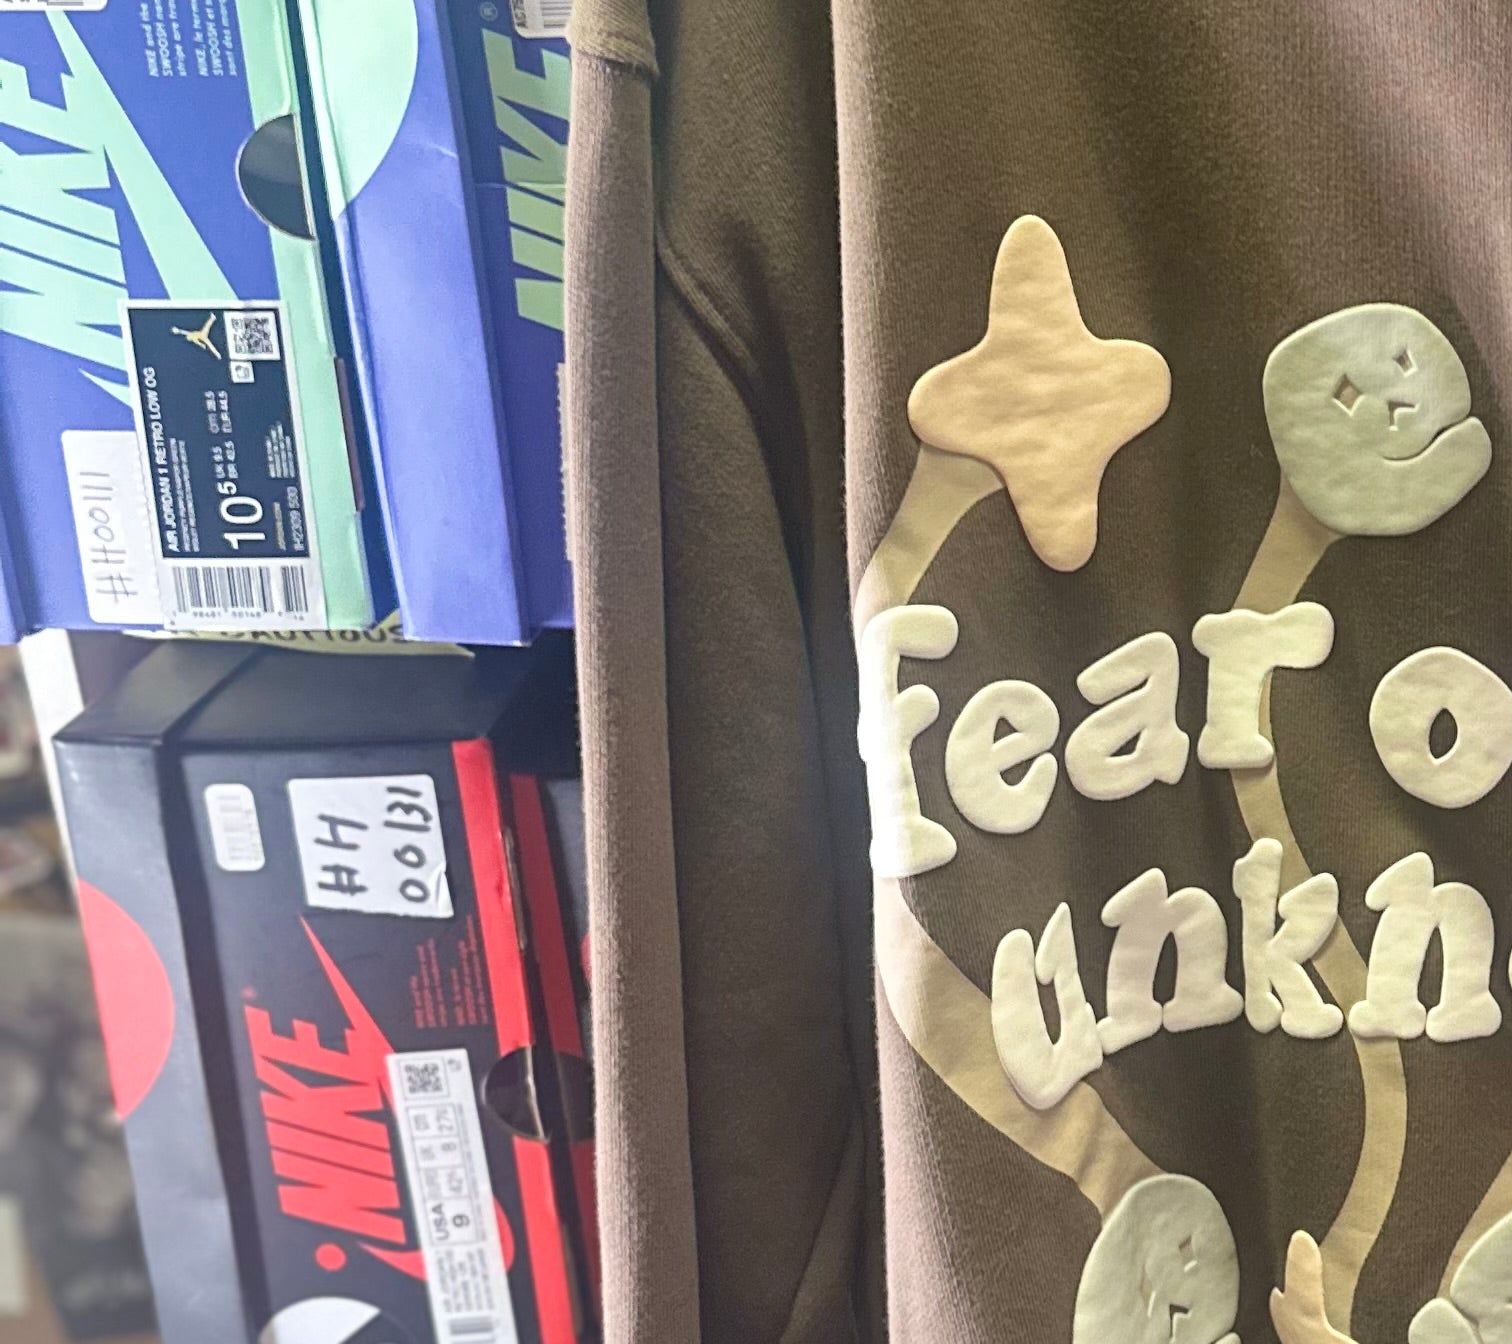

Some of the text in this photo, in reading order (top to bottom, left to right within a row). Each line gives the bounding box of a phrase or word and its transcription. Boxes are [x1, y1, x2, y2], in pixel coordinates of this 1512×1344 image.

[140, 3, 160, 77] NIKE and the
[155, 22, 173, 77] SWOOSH
[172, 21, 182, 42] are
[206, 21, 224, 77] SWOOSH
[143, 367, 157, 389] OG
[147, 389, 162, 421] LOW
[151, 422, 168, 466] RETRO
[159, 477, 176, 529] JORDAN
[165, 530, 181, 553] AIR
[858, 602, 1333, 878] fear
[314, 814, 369, 851] H
[245, 1003, 406, 1246] NIKE
[431, 1203, 450, 1242] USA
[452, 1213, 470, 1229] 9
